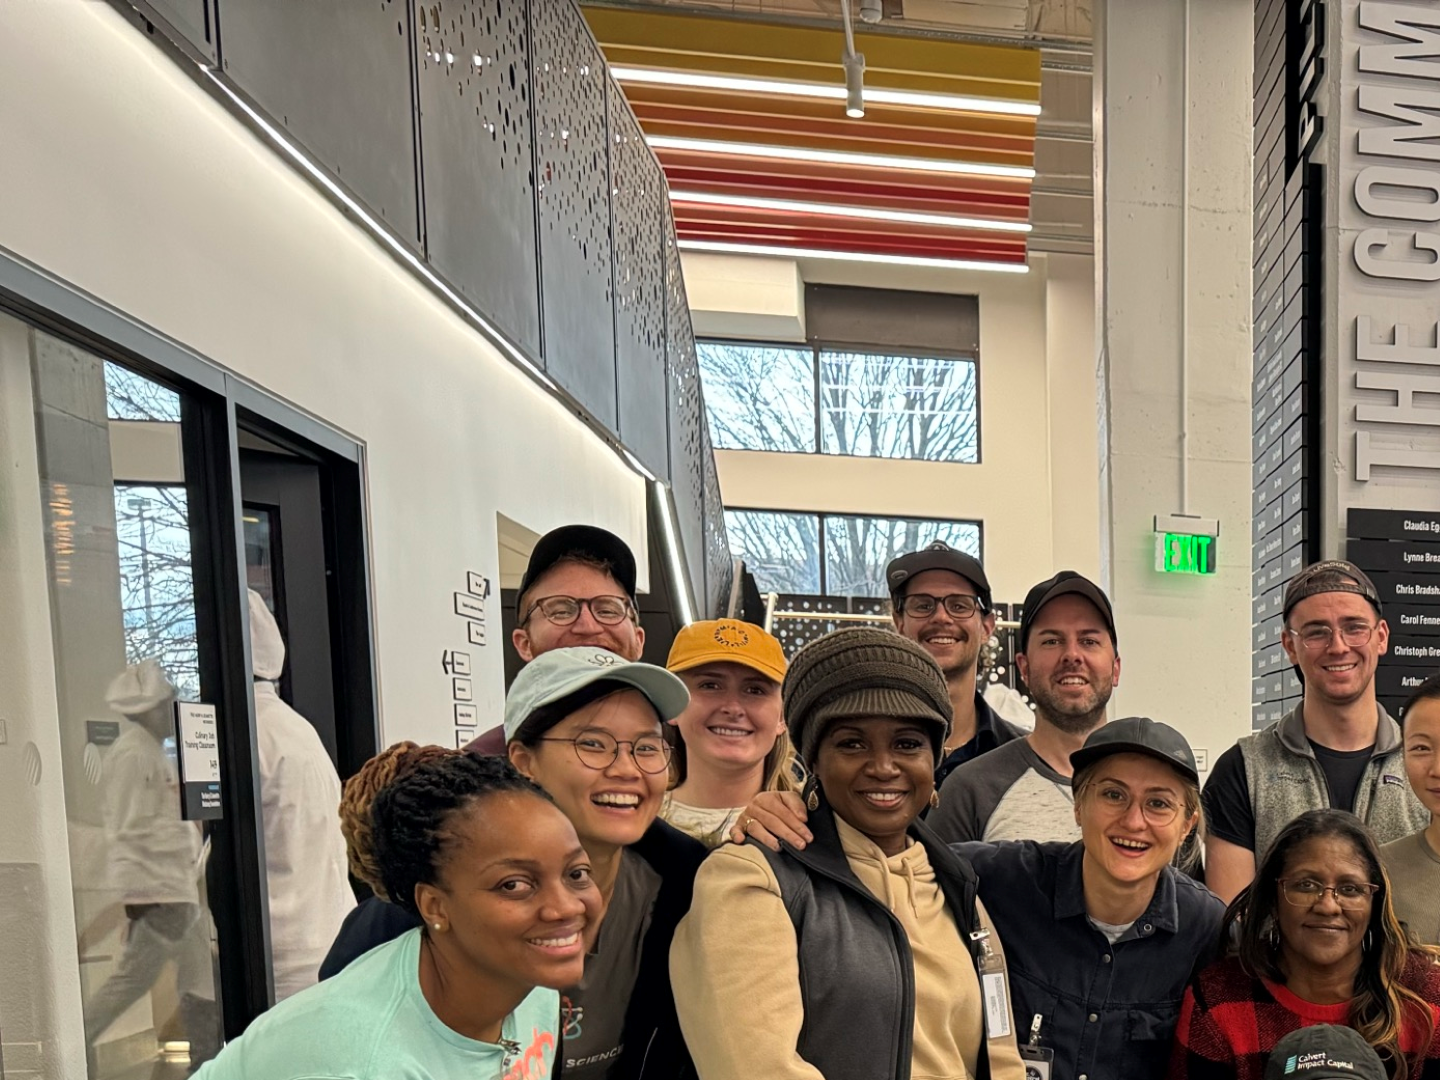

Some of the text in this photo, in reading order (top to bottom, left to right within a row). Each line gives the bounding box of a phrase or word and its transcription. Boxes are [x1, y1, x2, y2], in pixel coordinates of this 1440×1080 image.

[1404, 520, 1429, 531] Claudia
[1165, 533, 1211, 573] EXIT
[1404, 552, 1424, 563] Lynne
[1396, 584, 1414, 594] Chris
[1401, 615, 1418, 624] Carol
[1395, 646, 1427, 657] Christoph
[1298, 1052, 1326, 1062] Calvert
[1297, 1059, 1354, 1070] Impact Capital
